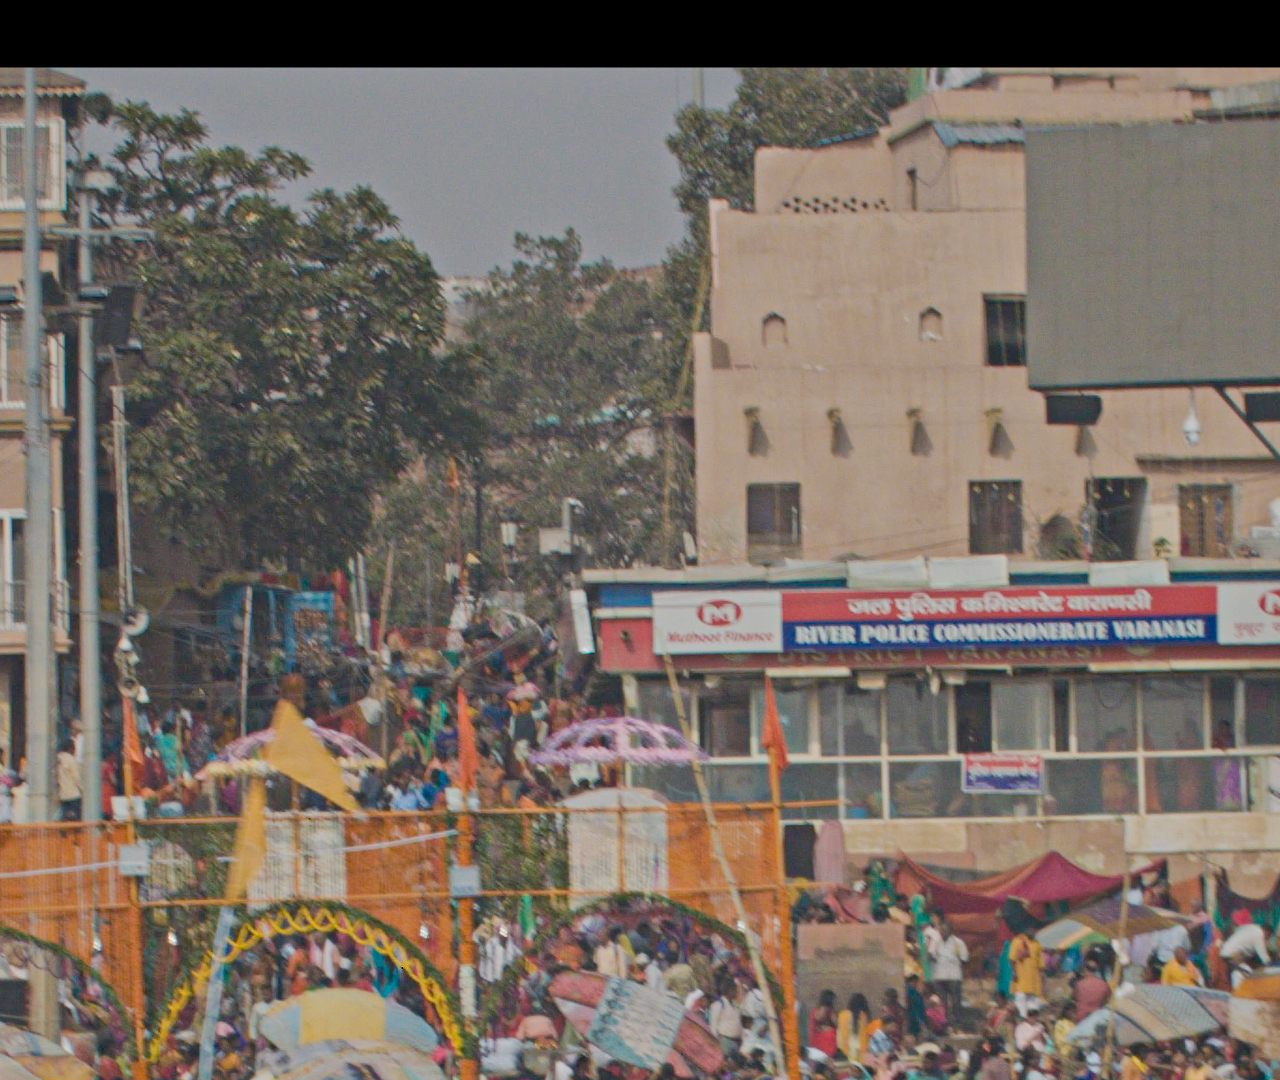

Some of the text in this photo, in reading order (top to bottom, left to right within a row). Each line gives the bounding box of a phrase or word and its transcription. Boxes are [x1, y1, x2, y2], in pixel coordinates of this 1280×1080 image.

[847, 598, 893, 616] जल
[895, 592, 957, 622] पुलिस
[1066, 589, 1152, 612] वाराणसी
[795, 619, 1206, 645] RIVER POLICE COMMISSIONERATE VARANASI
